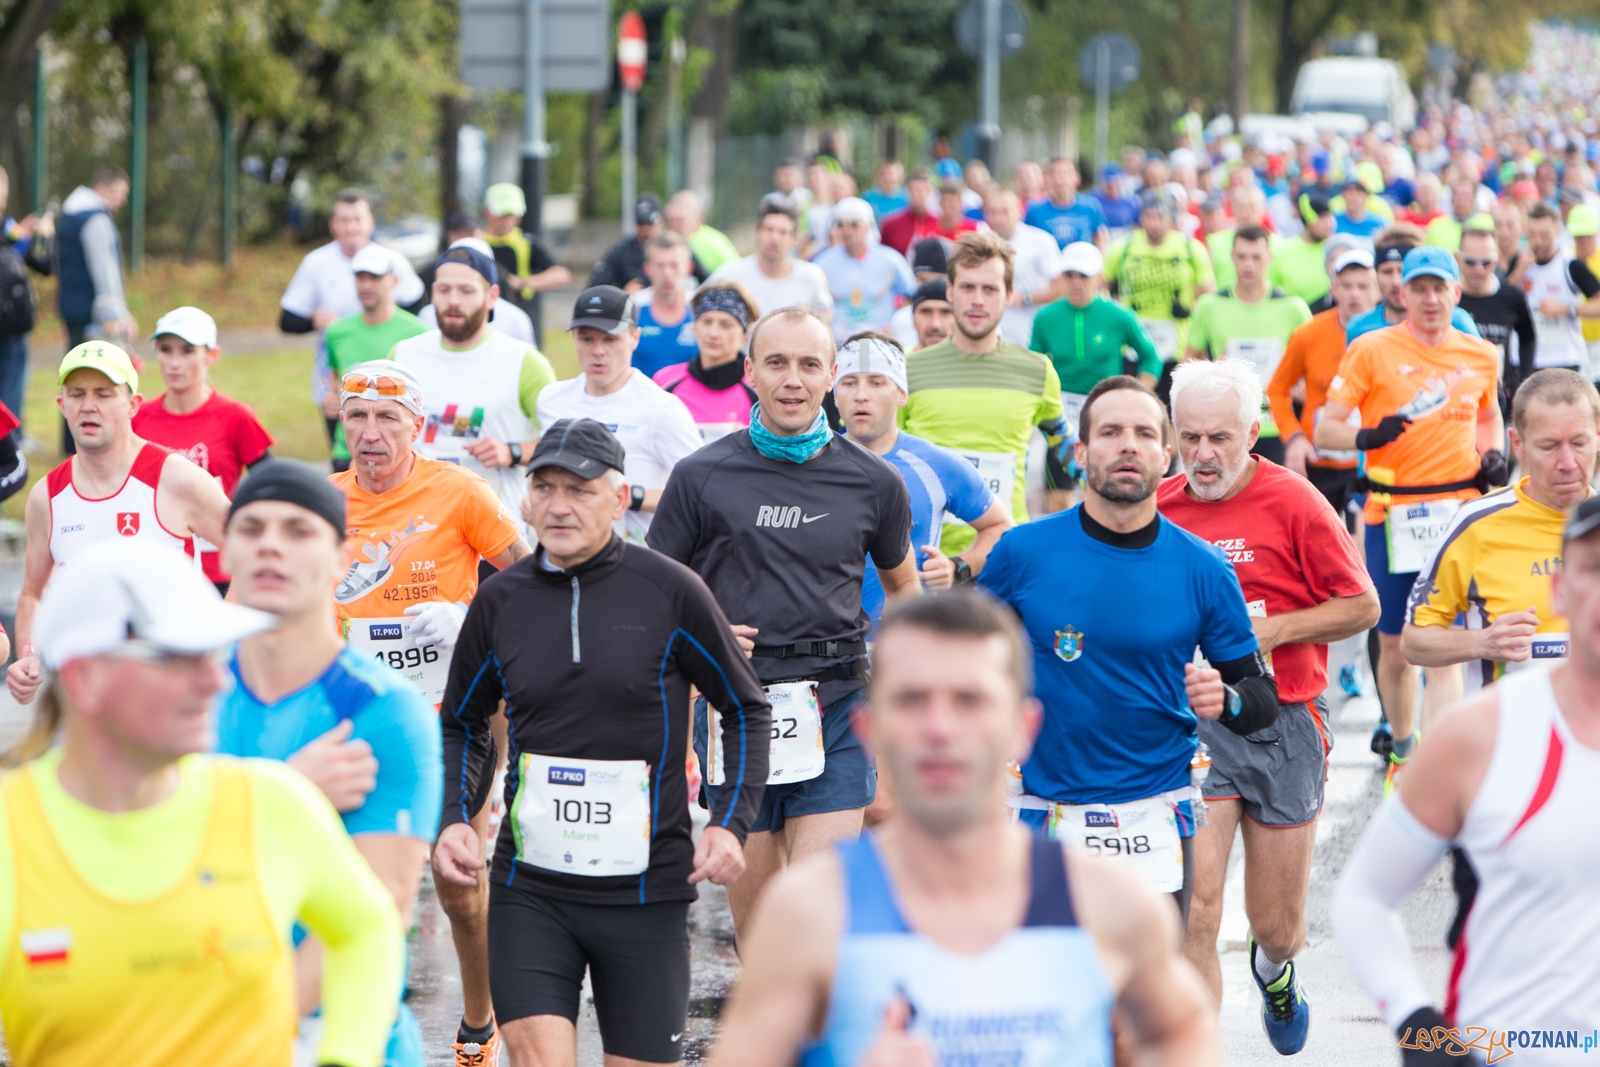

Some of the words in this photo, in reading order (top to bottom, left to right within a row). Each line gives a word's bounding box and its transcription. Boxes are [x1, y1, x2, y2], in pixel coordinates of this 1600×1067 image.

[755, 504, 802, 529] RUN
[411, 560, 436, 571] 17.04
[411, 571, 436, 583] 2016
[383, 585, 438, 601] 42.195m
[550, 770, 584, 783] 17.PKO
[553, 798, 612, 824] 1013
[563, 829, 600, 841] Marek
[1085, 835, 1151, 857] 5918
